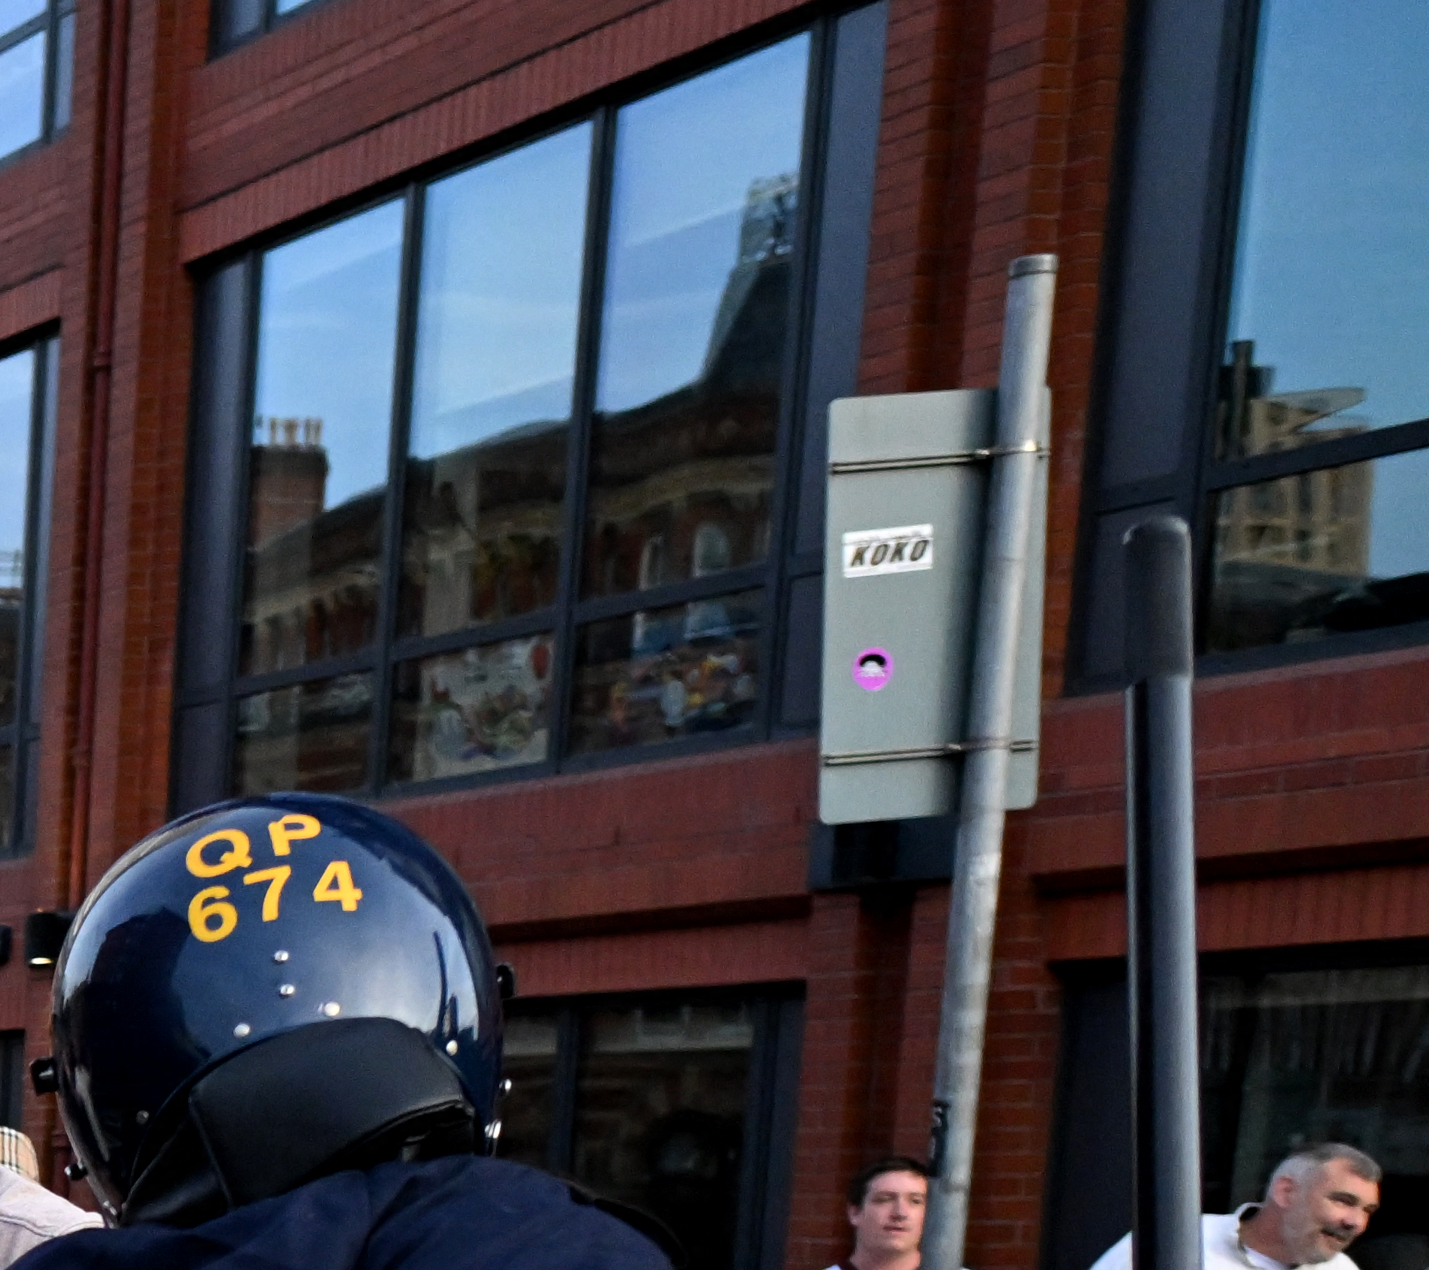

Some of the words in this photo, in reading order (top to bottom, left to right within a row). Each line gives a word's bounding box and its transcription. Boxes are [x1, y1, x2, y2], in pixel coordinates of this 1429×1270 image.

[850, 540, 929, 567] KOKO
[186, 814, 321, 878] QP
[189, 861, 363, 943] 674
